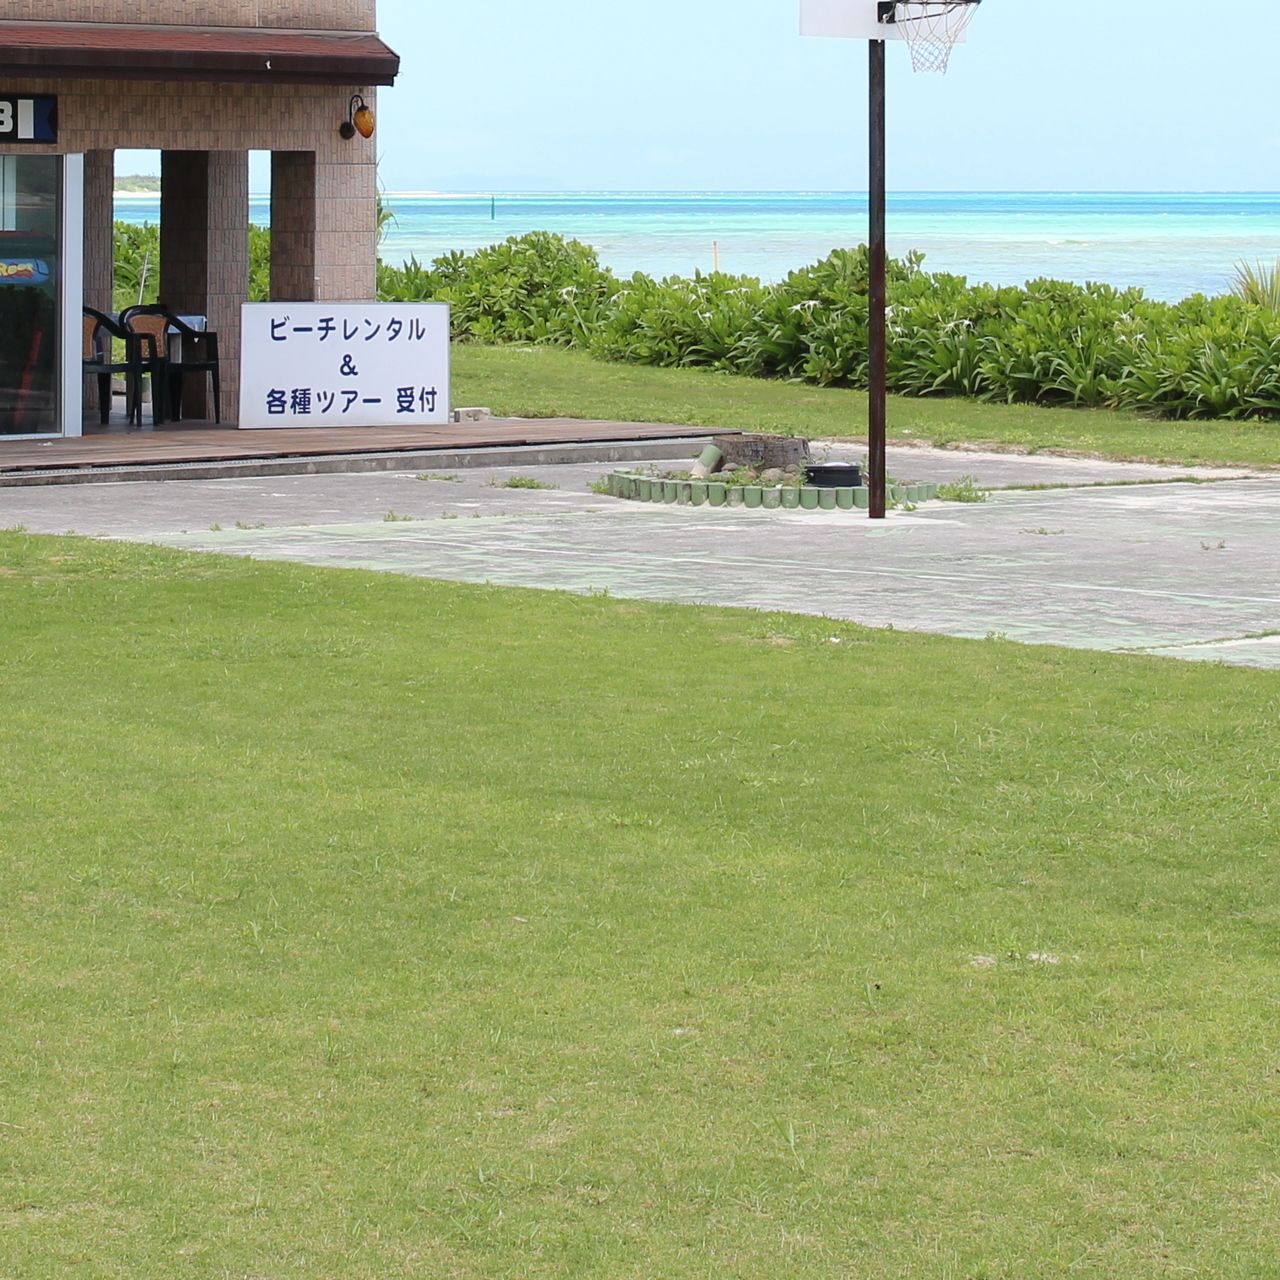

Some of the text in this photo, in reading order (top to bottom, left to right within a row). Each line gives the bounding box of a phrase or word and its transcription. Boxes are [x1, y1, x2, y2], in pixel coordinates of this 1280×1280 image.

[270, 315, 426, 341] ビーチレンタル
[339, 354, 359, 376] &
[266, 386, 438, 415] 各種ツアー 受付
